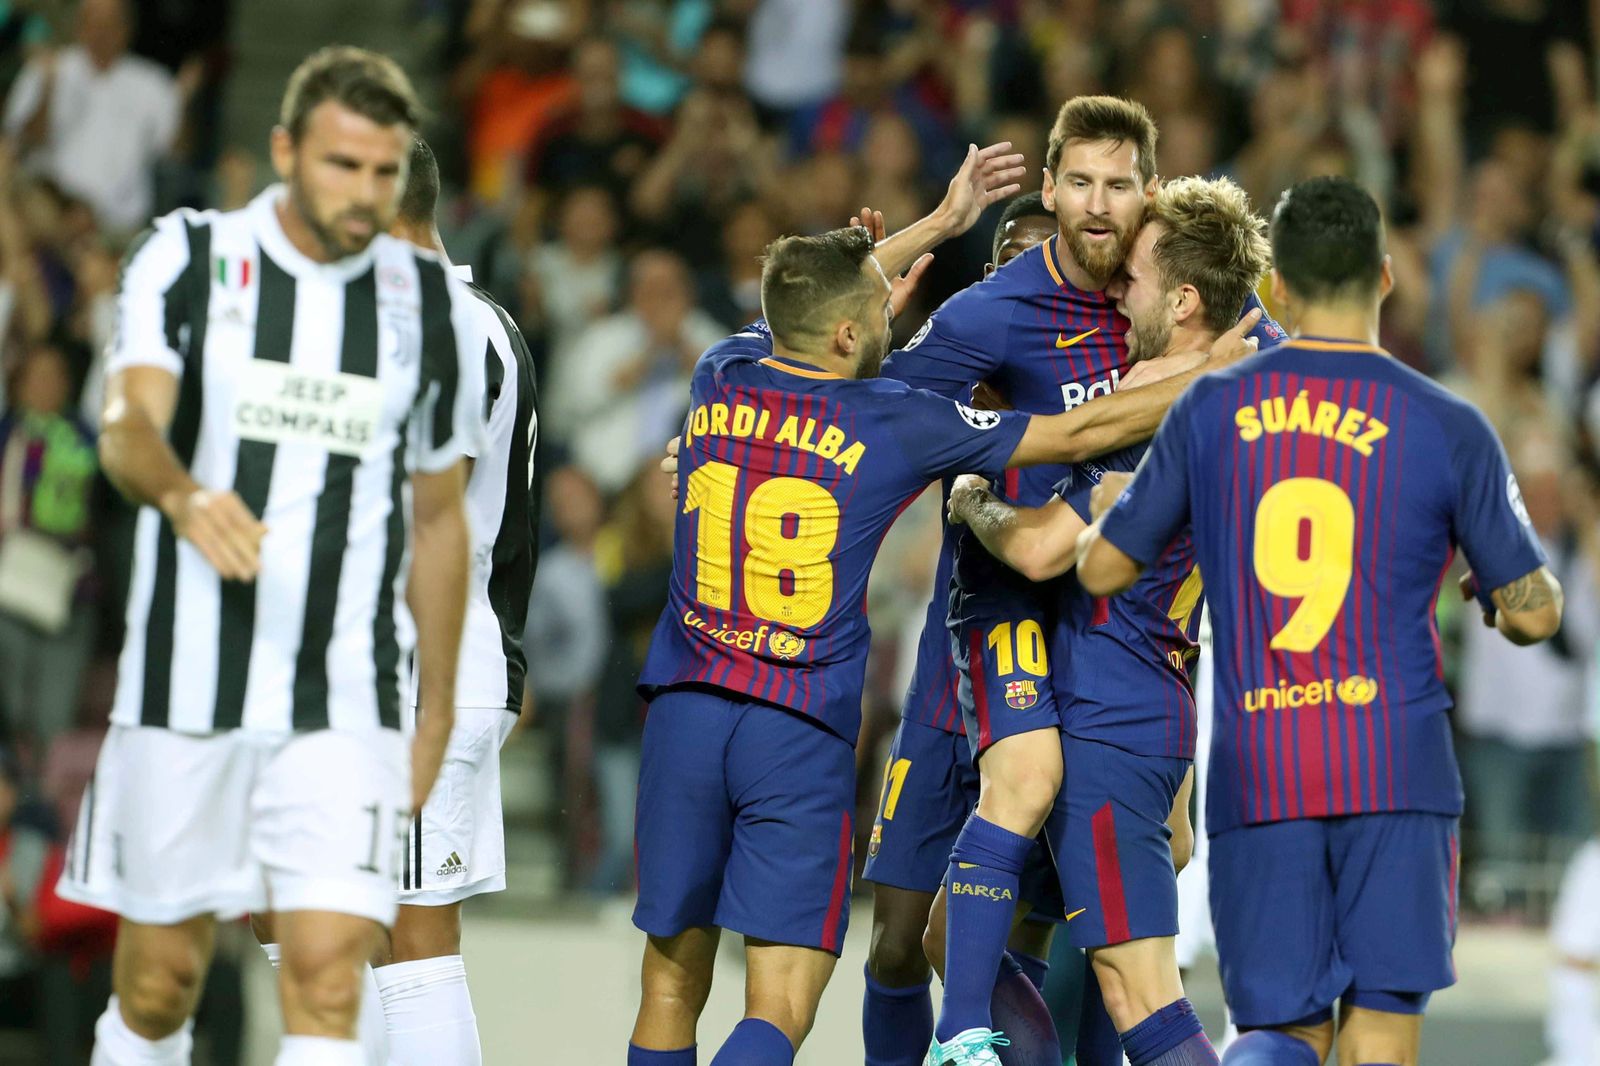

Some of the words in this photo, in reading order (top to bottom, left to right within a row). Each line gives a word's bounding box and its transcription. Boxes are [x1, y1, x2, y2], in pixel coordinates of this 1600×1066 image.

[280, 376, 347, 403] JEEP
[235, 402, 371, 443] COMPASS
[774, 415, 866, 476] ALBA
[1235, 389, 1390, 457] SUÁREZ
[683, 461, 840, 628] 18
[1253, 477, 1355, 652] 9
[988, 619, 1048, 677] 10
[1244, 678, 1334, 713] unicef
[436, 864, 467, 876] adidas
[952, 881, 1012, 902] BARÇA
